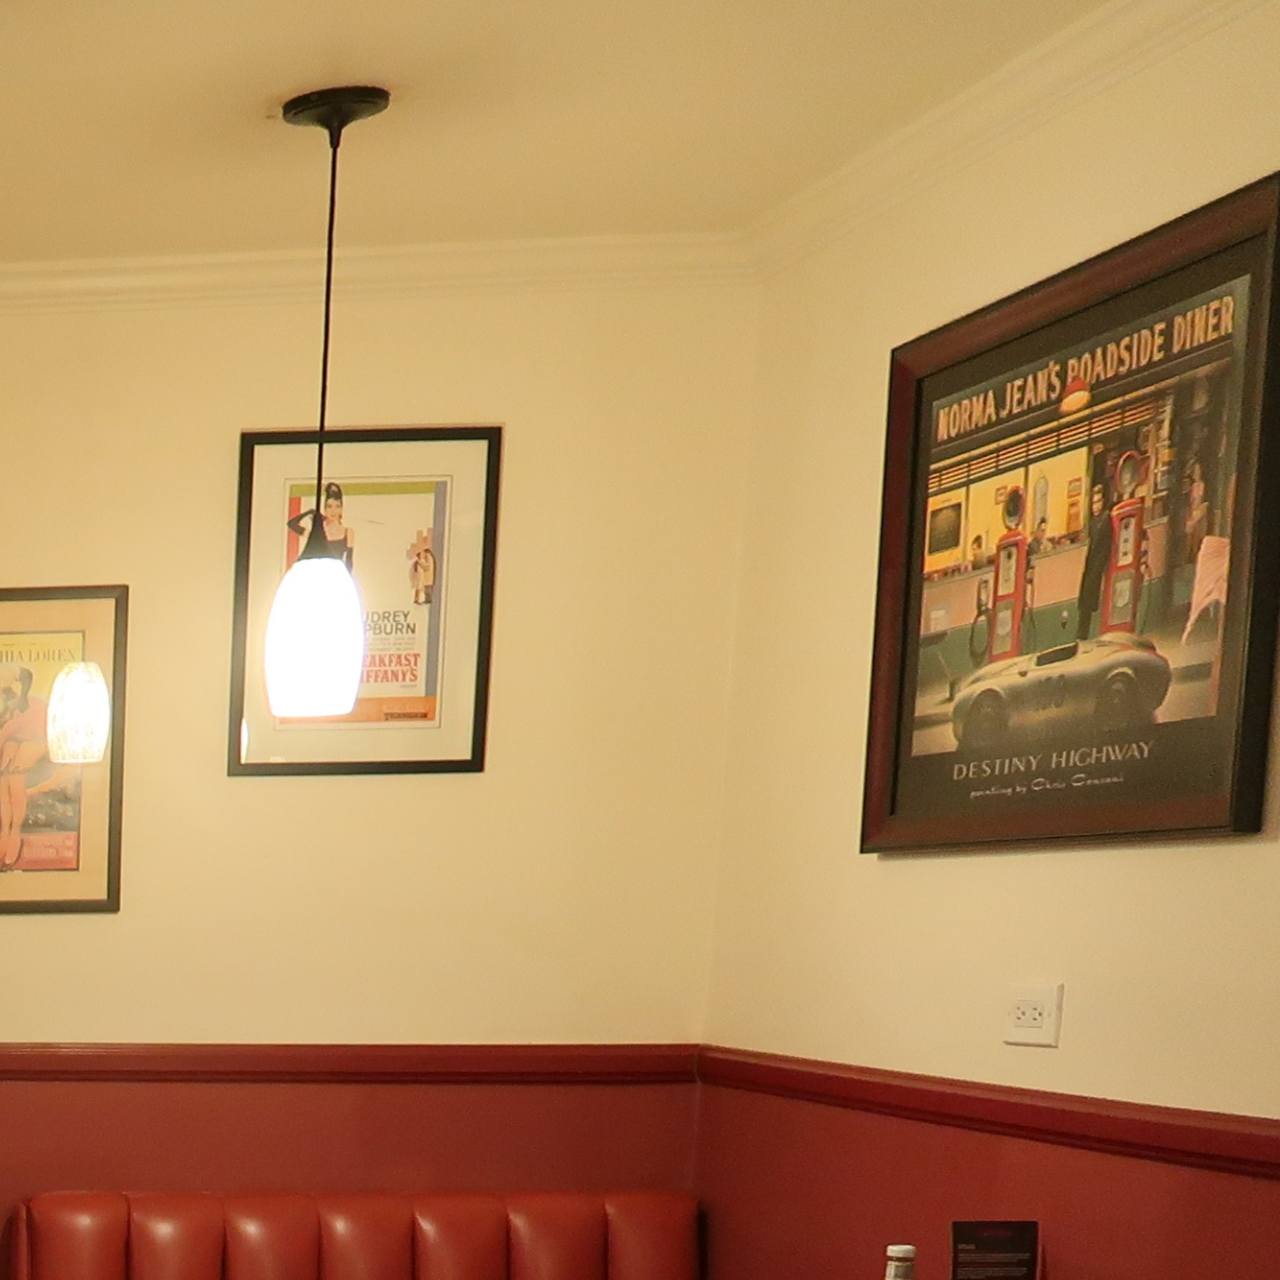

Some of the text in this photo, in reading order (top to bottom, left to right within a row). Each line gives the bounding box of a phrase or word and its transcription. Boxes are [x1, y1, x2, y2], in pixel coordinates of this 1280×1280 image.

[937, 296, 1235, 443] NORMA JEAN'S ROADSIDE DINER
[363, 610, 410, 624] UDREY
[364, 622, 416, 636] PBURN
[28, 647, 77, 663] LOREN
[360, 668, 418, 683] IFFANY'S
[952, 740, 1155, 781] DESTINY HIGHWAY
[1015, 785, 1027, 793] by
